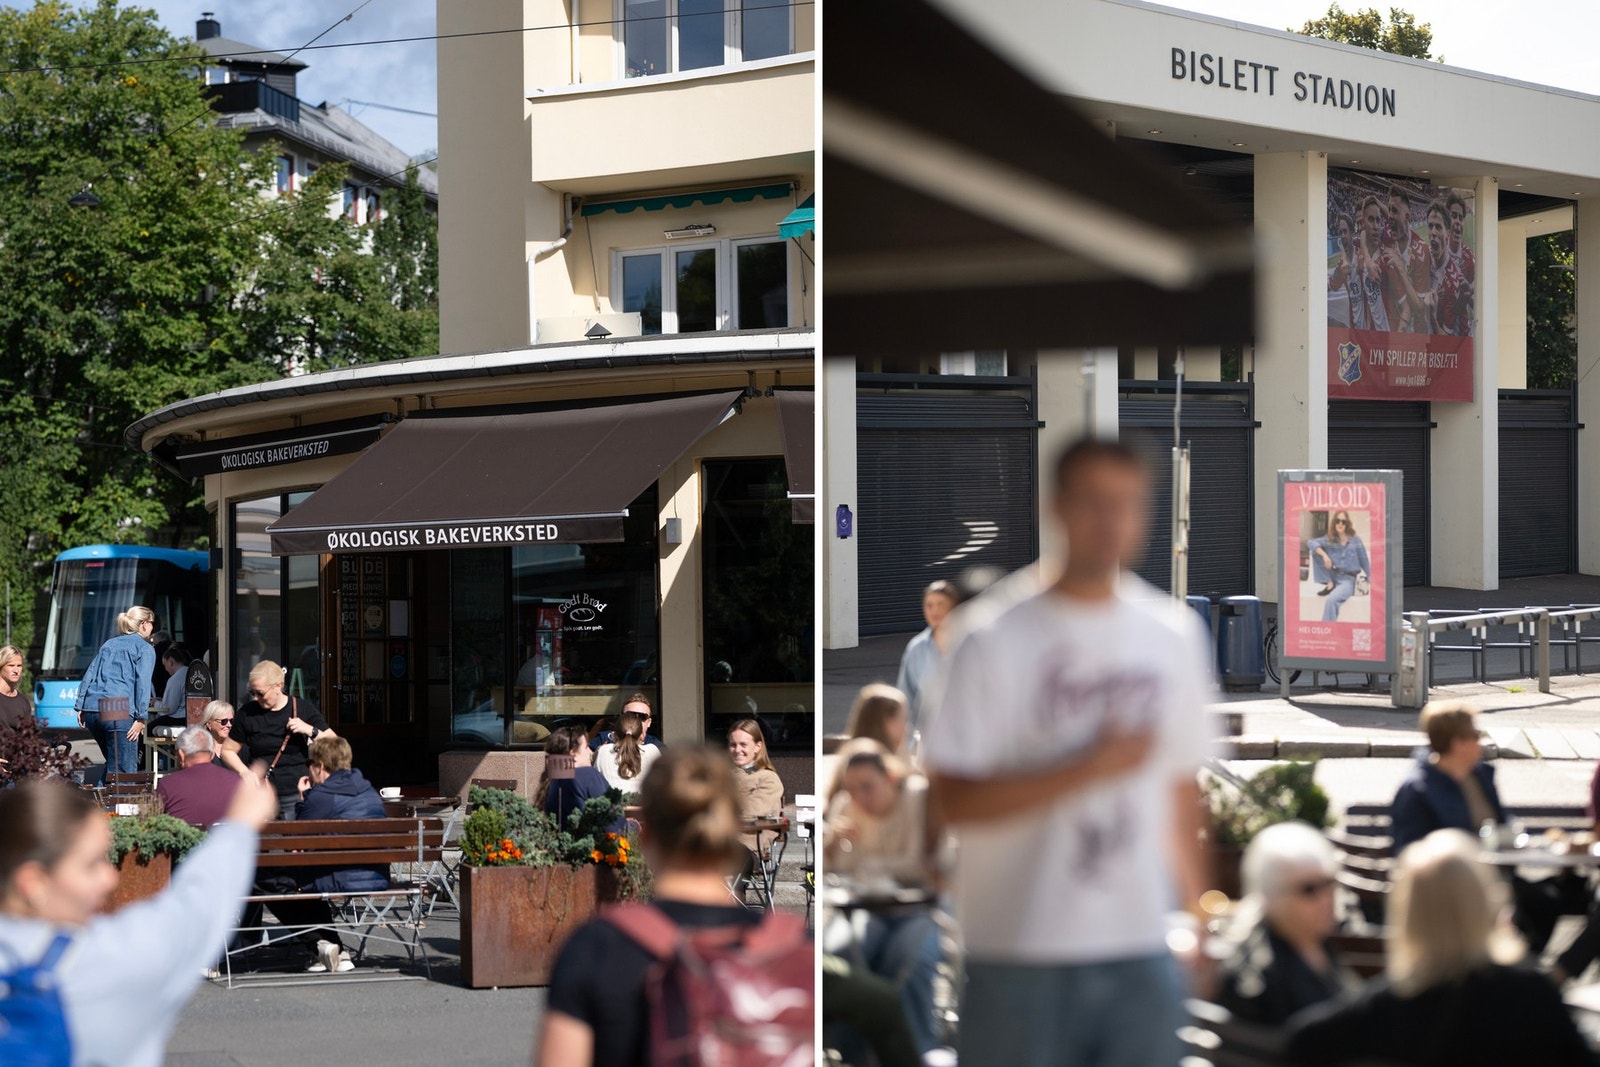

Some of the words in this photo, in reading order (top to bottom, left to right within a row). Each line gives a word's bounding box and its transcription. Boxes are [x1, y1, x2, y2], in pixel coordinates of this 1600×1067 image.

[1172, 47, 1279, 96] BISLETT
[1293, 71, 1396, 117] STADION
[1369, 349, 1384, 366] LYN
[1386, 350, 1416, 367] SPILLER
[221, 450, 266, 470] ØKOLOGISK
[267, 440, 330, 463] BAKEVERKSTED
[1299, 485, 1371, 508] VILLOID
[327, 527, 420, 551] ØKOLOGISK
[425, 524, 558, 545] BAKEVERKSTED
[558, 593, 581, 614] Godt
[582, 592, 608, 613] Brød
[1298, 626, 1311, 634] HEI
[1311, 626, 1332, 634] OSLO!
